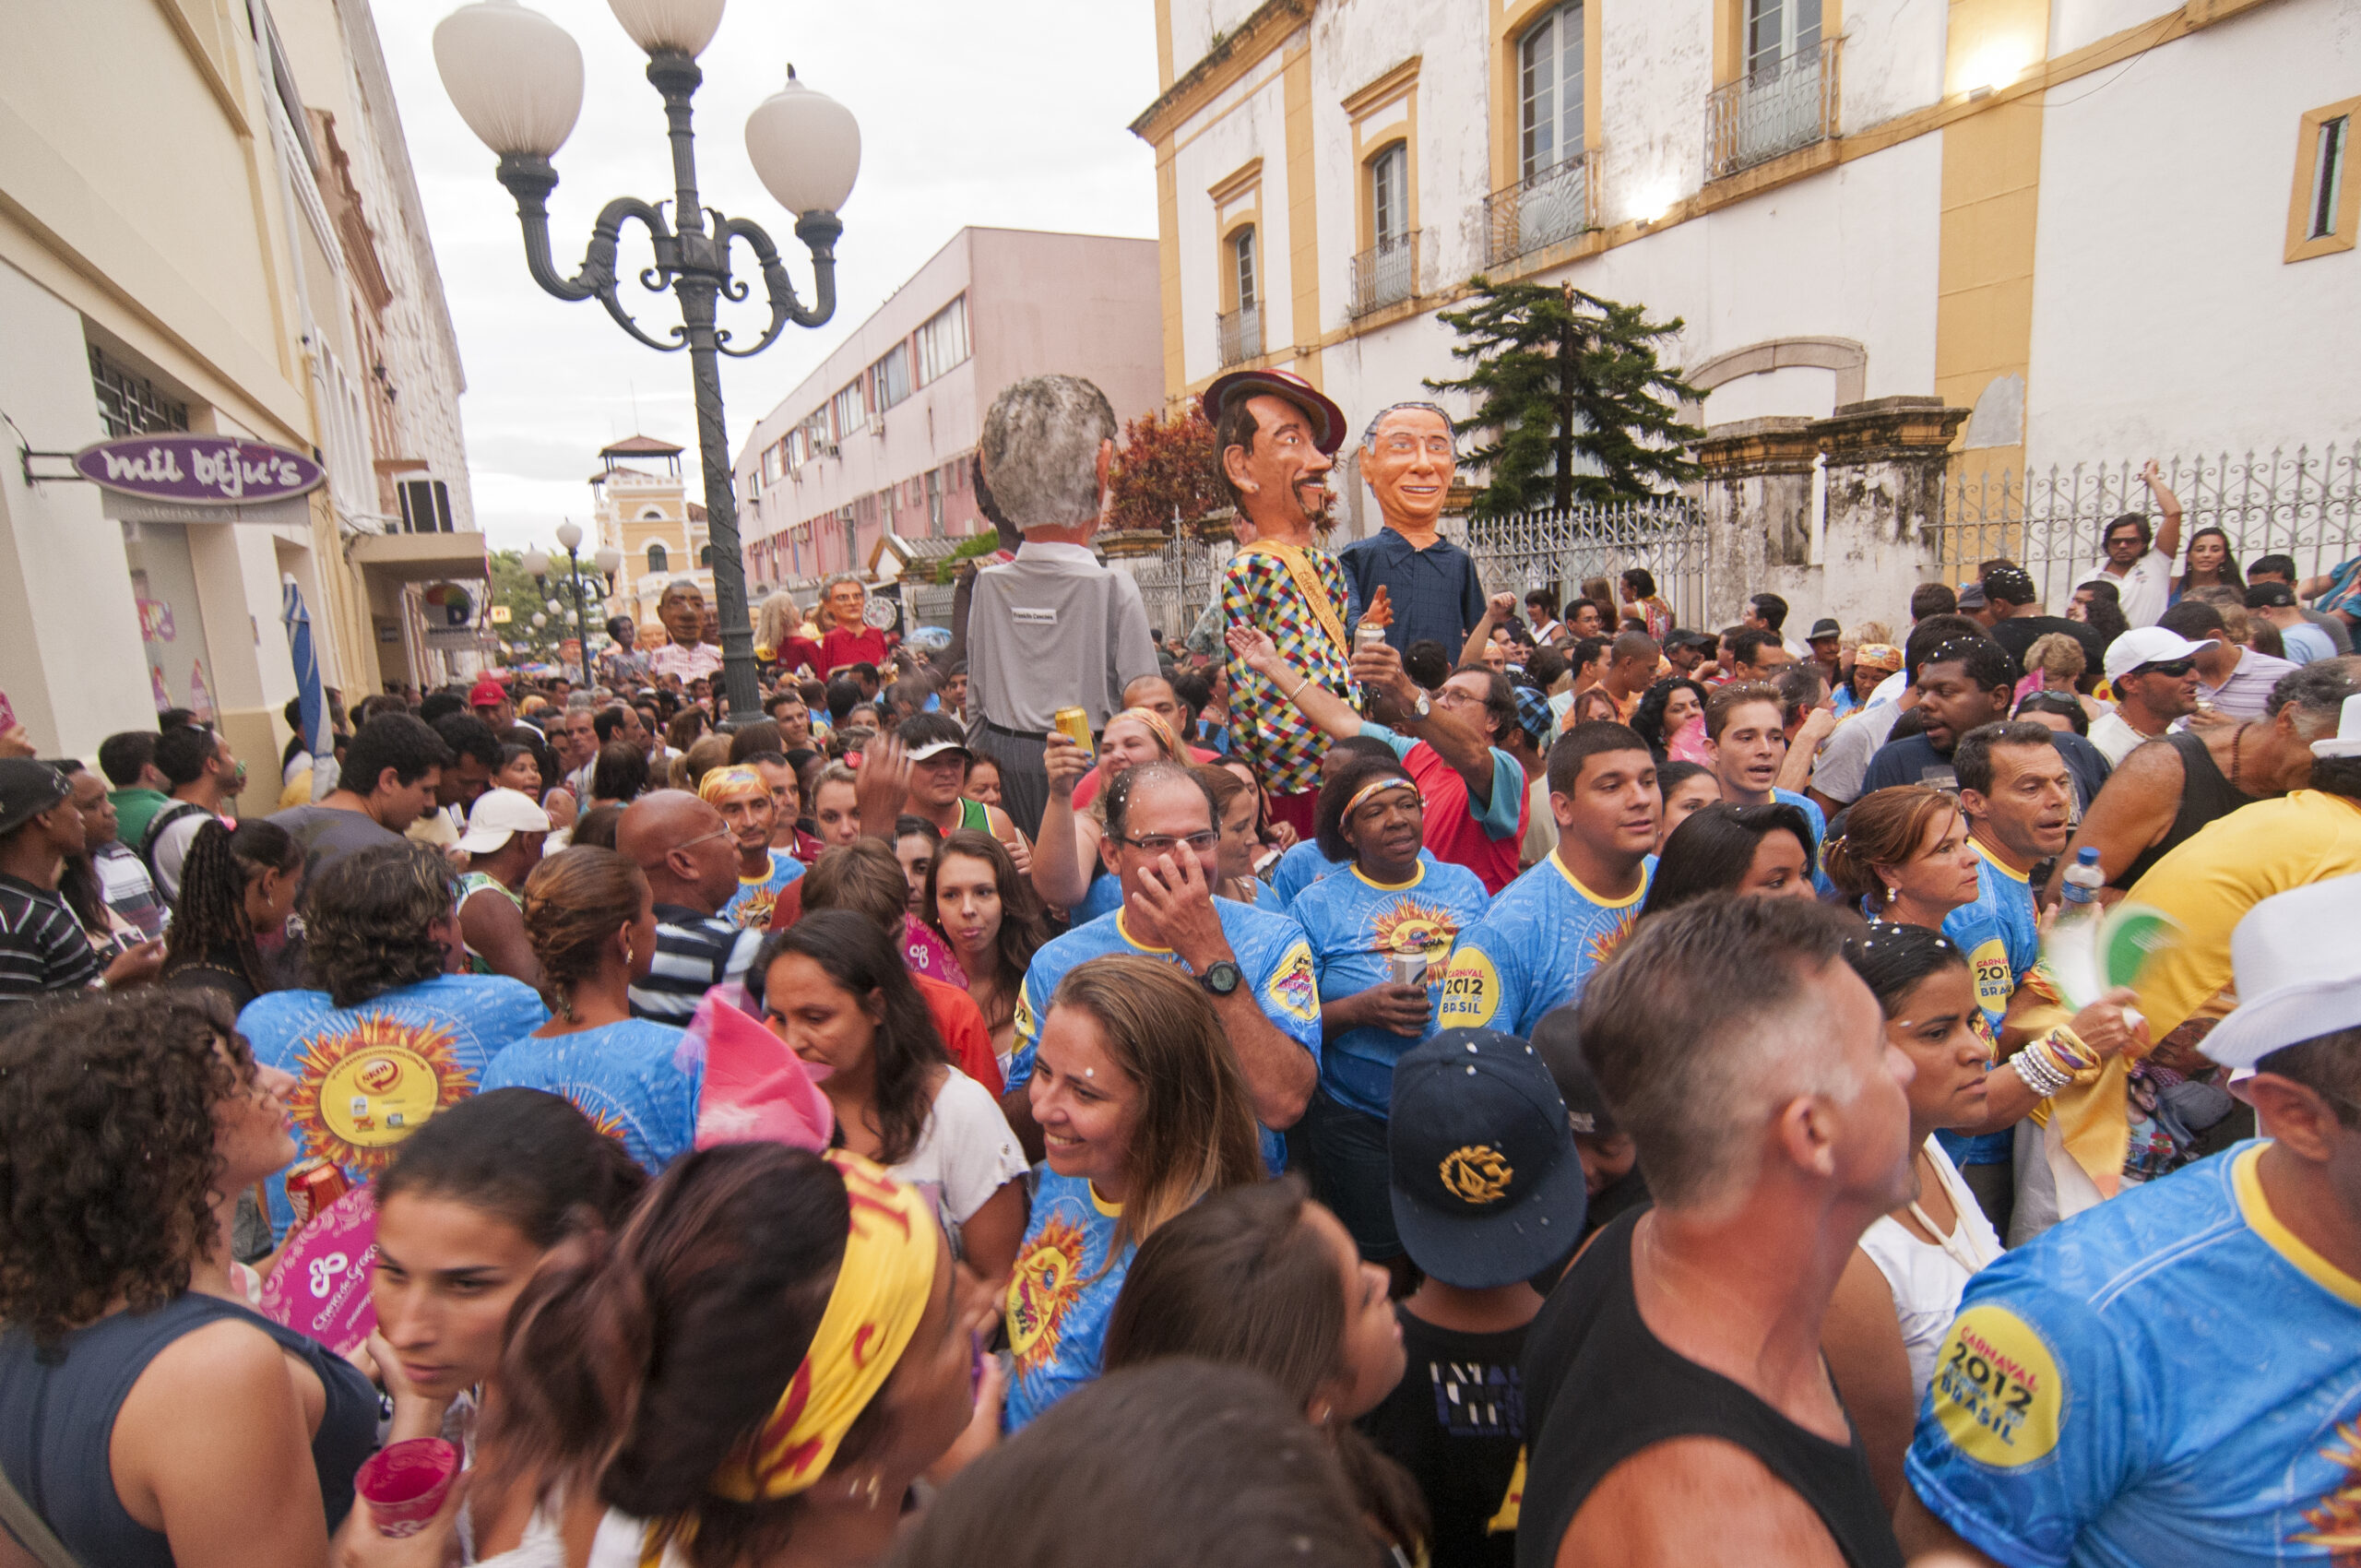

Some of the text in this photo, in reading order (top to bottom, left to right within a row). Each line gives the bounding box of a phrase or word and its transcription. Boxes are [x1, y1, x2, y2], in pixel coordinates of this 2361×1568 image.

[100, 446, 303, 498] mil biju's
[1445, 978, 1483, 995] 2012
[1976, 957, 2009, 968] CARNA
[1977, 965, 2011, 981] 201
[1950, 1341, 2034, 1417] 2012
[1960, 1325, 2038, 1393] CARNAVAL
[1940, 1372, 2015, 1447] BRASIL
